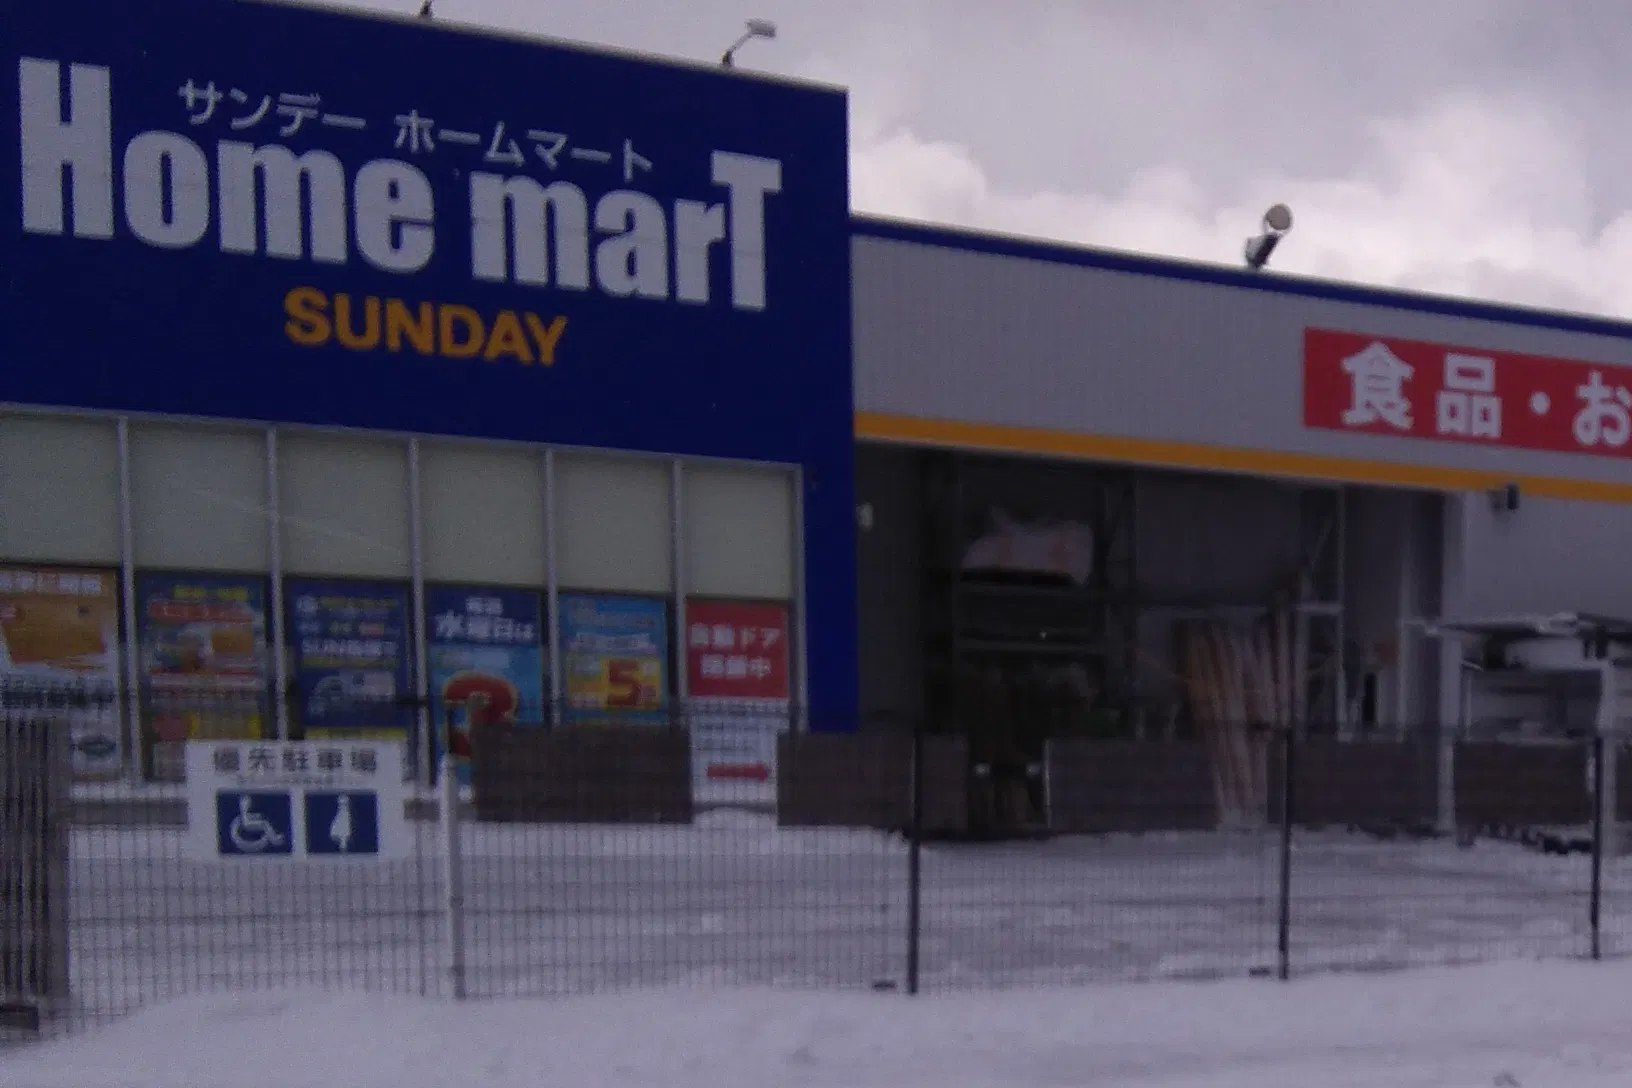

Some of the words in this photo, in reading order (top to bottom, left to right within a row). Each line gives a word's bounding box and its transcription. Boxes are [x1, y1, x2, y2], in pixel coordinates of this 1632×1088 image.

[19, 56, 434, 273] Home
[178, 79, 367, 137] サンデー
[394, 109, 653, 180] ホームマート
[283, 286, 568, 366] SUNDAY
